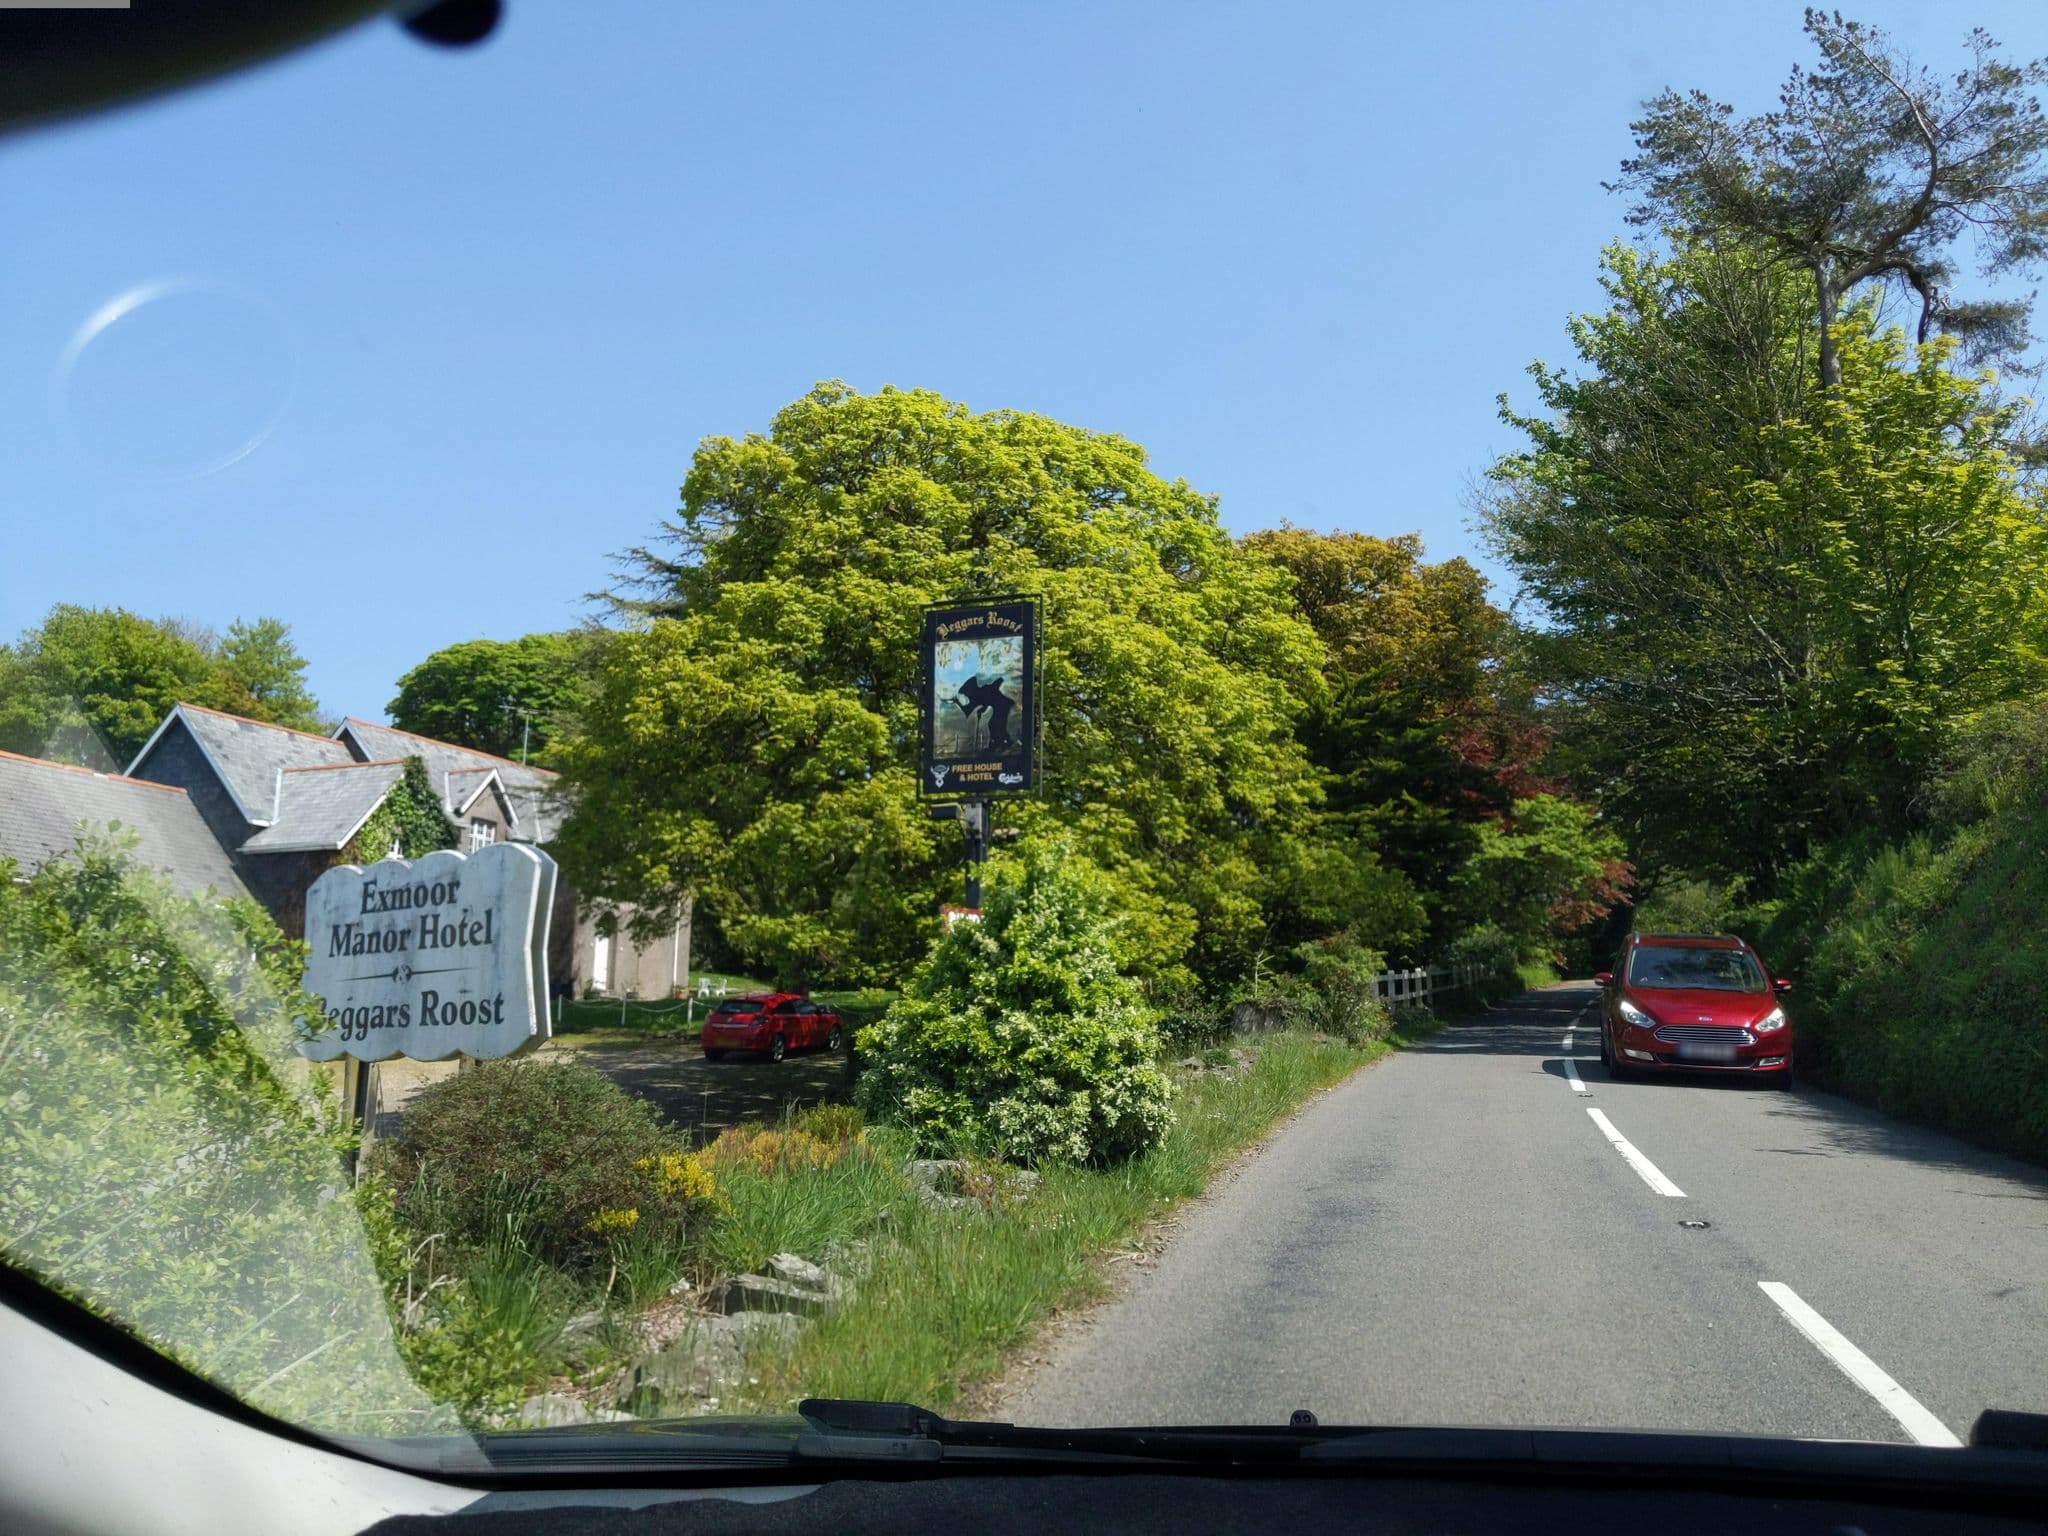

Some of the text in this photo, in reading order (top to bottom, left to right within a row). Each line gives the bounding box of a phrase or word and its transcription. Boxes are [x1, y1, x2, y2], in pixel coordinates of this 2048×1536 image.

[936, 611, 1023, 640] Beggars Roost
[952, 762, 1003, 773] FREE HOUSE
[967, 773, 994, 781] HOTEL
[360, 880, 460, 914] Exmoor
[329, 909, 493, 958] Manor Hotel
[418, 990, 505, 1026] Roost
